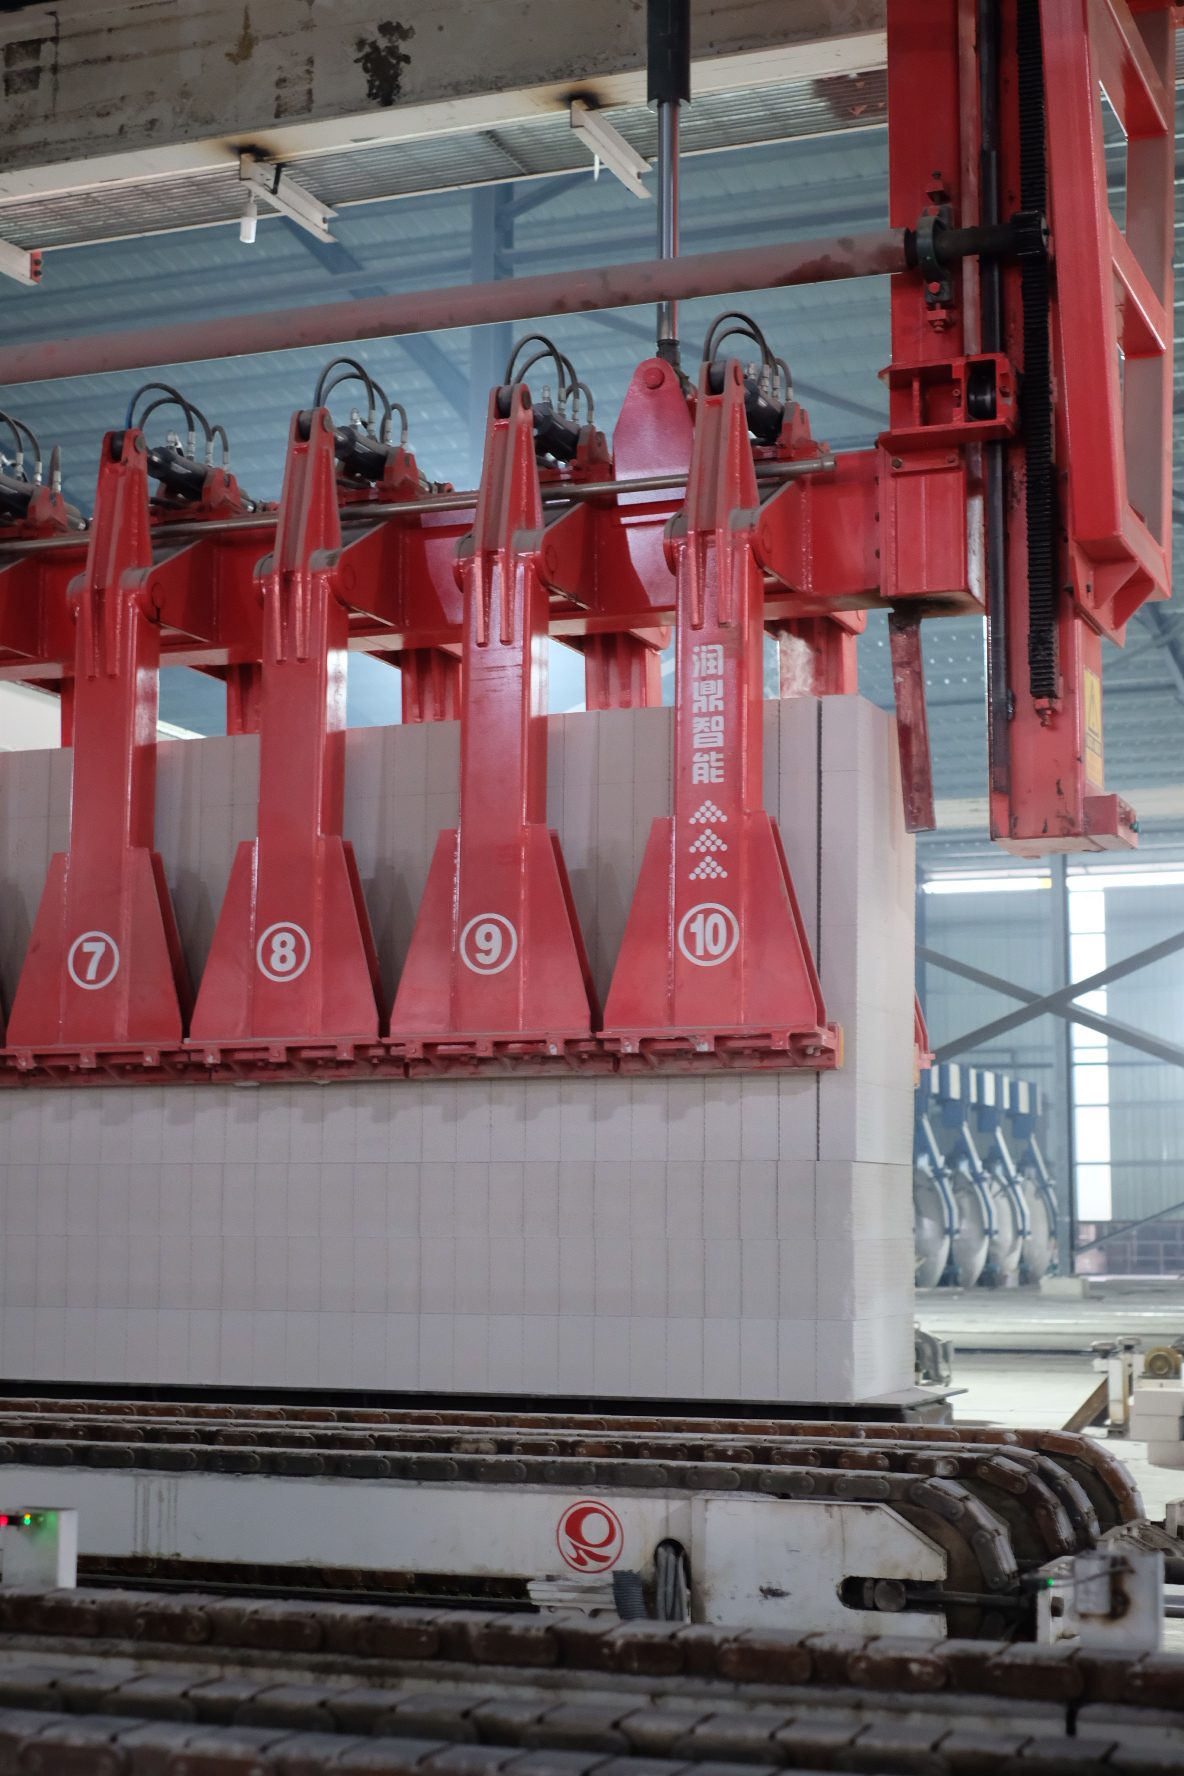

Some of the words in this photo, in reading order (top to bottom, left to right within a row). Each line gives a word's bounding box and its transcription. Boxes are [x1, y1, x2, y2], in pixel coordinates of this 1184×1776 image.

[692, 644, 725, 785] 润鼎智能
[270, 931, 297, 973] 8
[474, 923, 503, 965] 9
[689, 913, 727, 956] 10
[82, 941, 106, 981] 7
